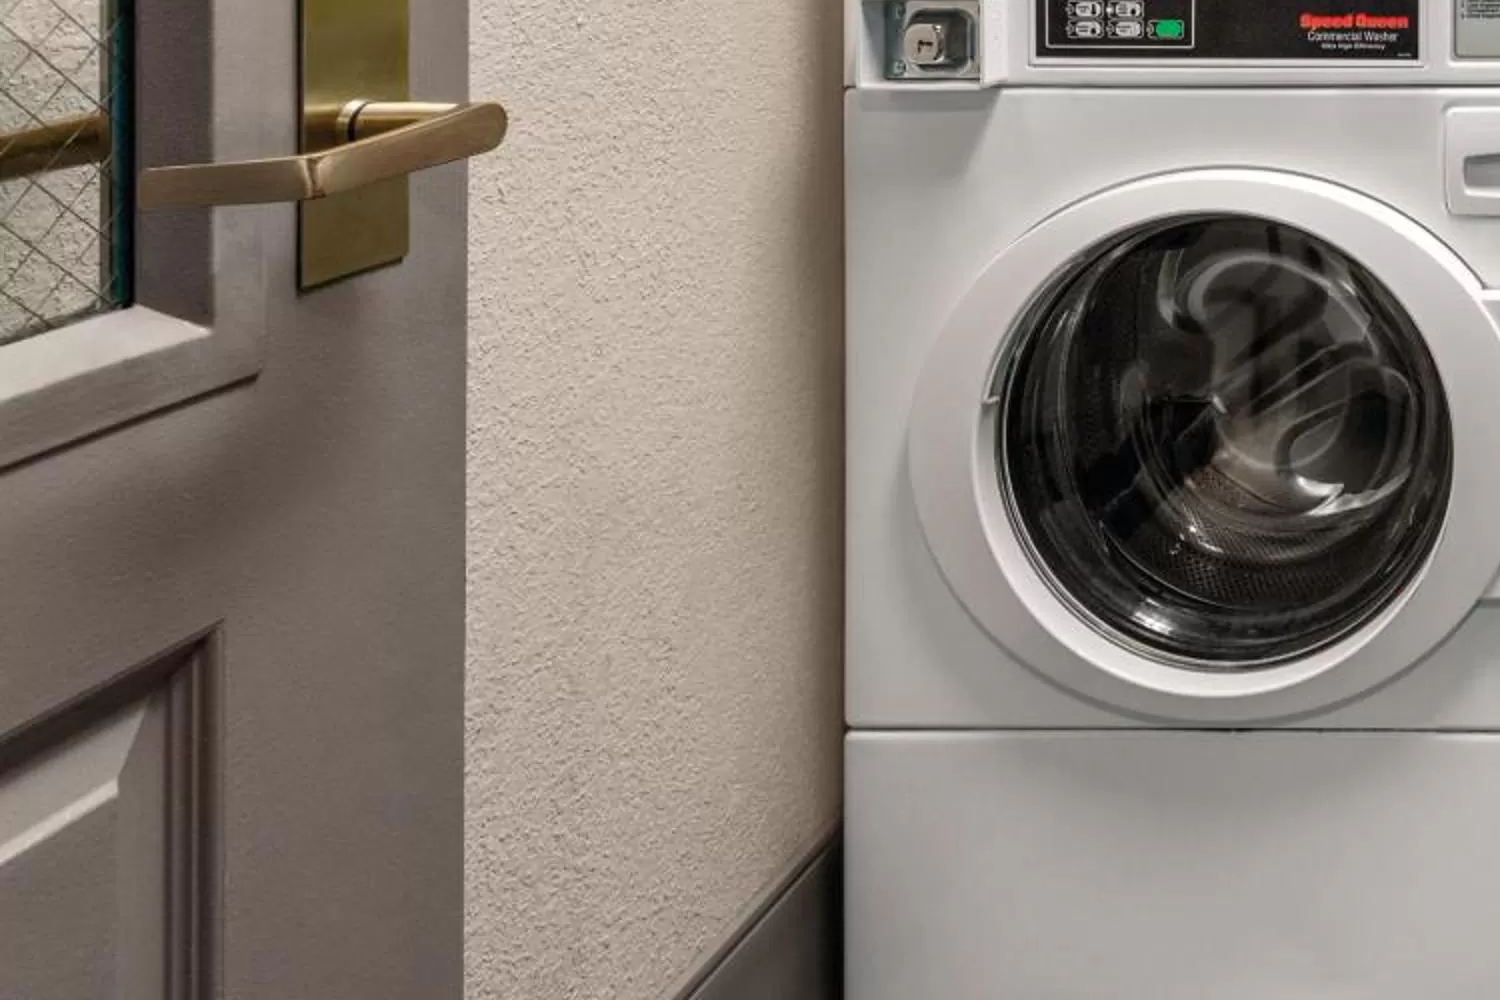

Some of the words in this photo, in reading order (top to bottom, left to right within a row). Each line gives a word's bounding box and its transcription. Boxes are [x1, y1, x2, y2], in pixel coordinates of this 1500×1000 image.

[1299, 12, 1354, 31] Speed
[1355, 12, 1409, 29] Queen
[1307, 31, 1363, 42] Commercial
[1364, 31, 1398, 42] Washer
